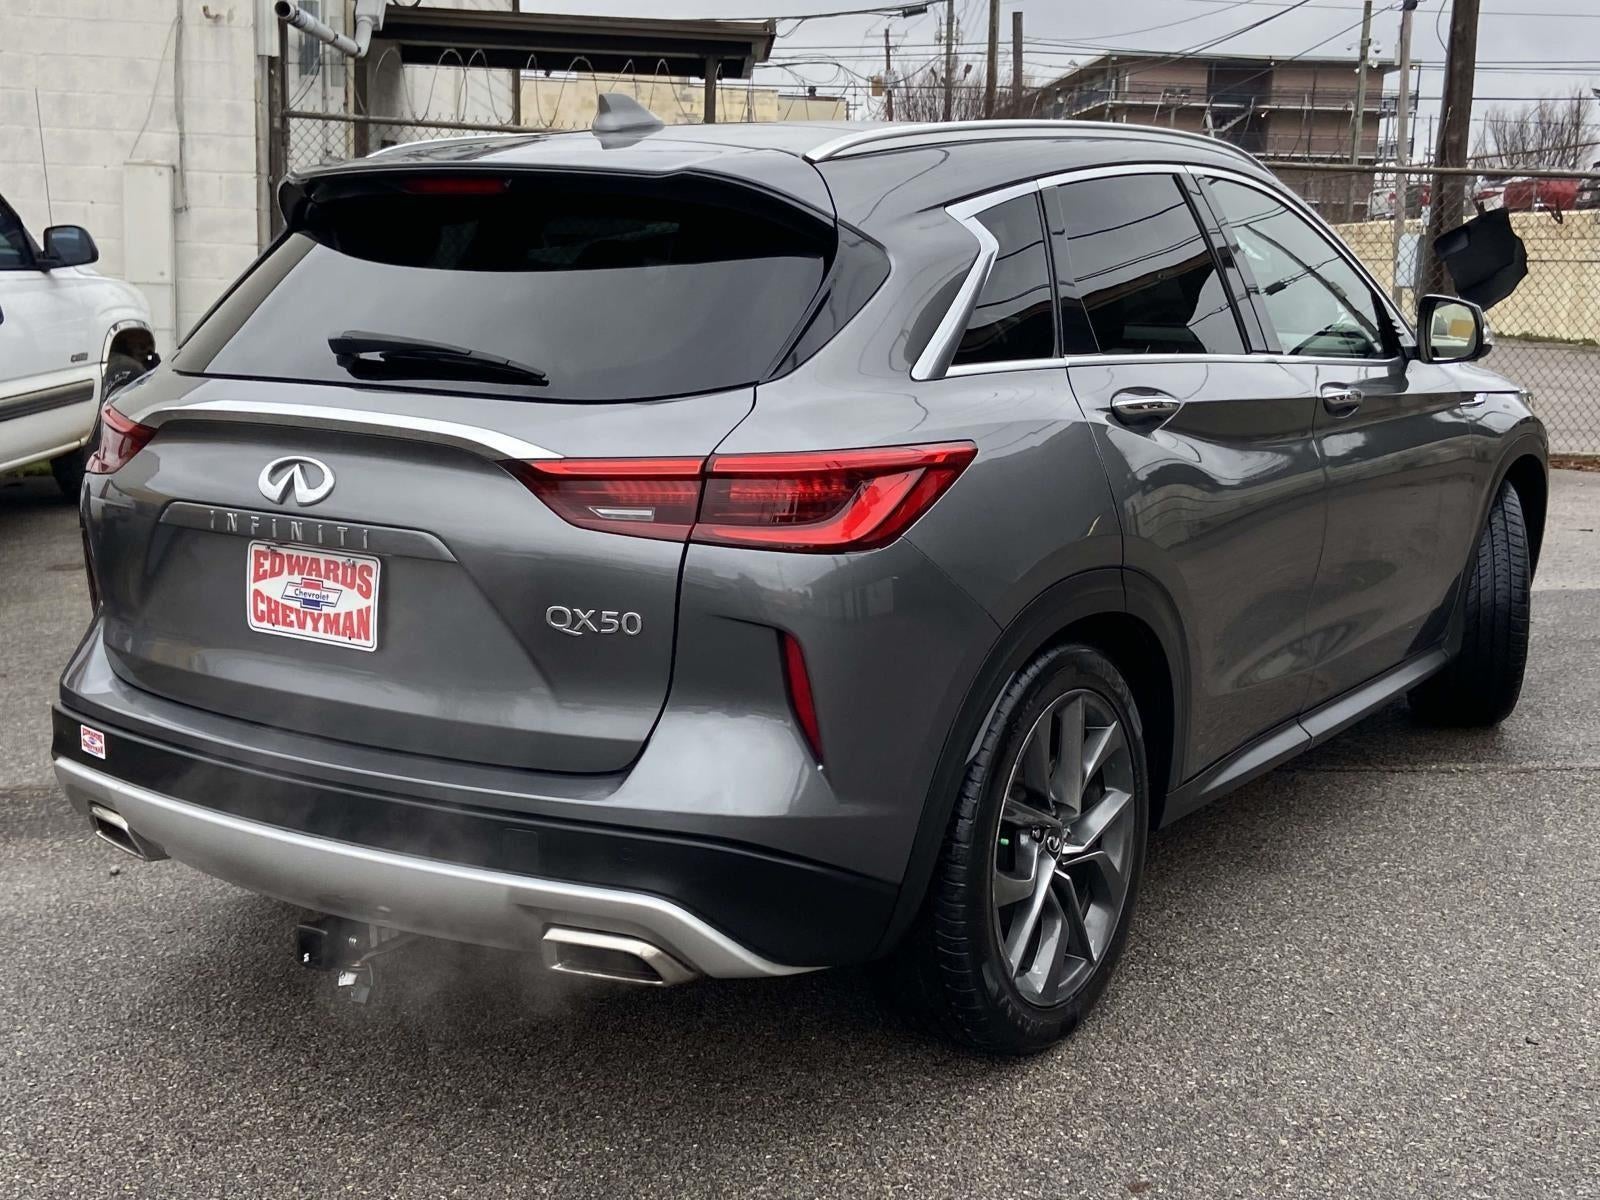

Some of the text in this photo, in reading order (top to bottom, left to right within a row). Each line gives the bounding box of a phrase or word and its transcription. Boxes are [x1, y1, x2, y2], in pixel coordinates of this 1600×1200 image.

[209, 509, 369, 549] INFINITI
[252, 549, 373, 600] EDWARDS
[294, 588, 329, 601] Chevrolet
[252, 588, 371, 641] CHEVYMAN
[545, 605, 642, 636] QX50
